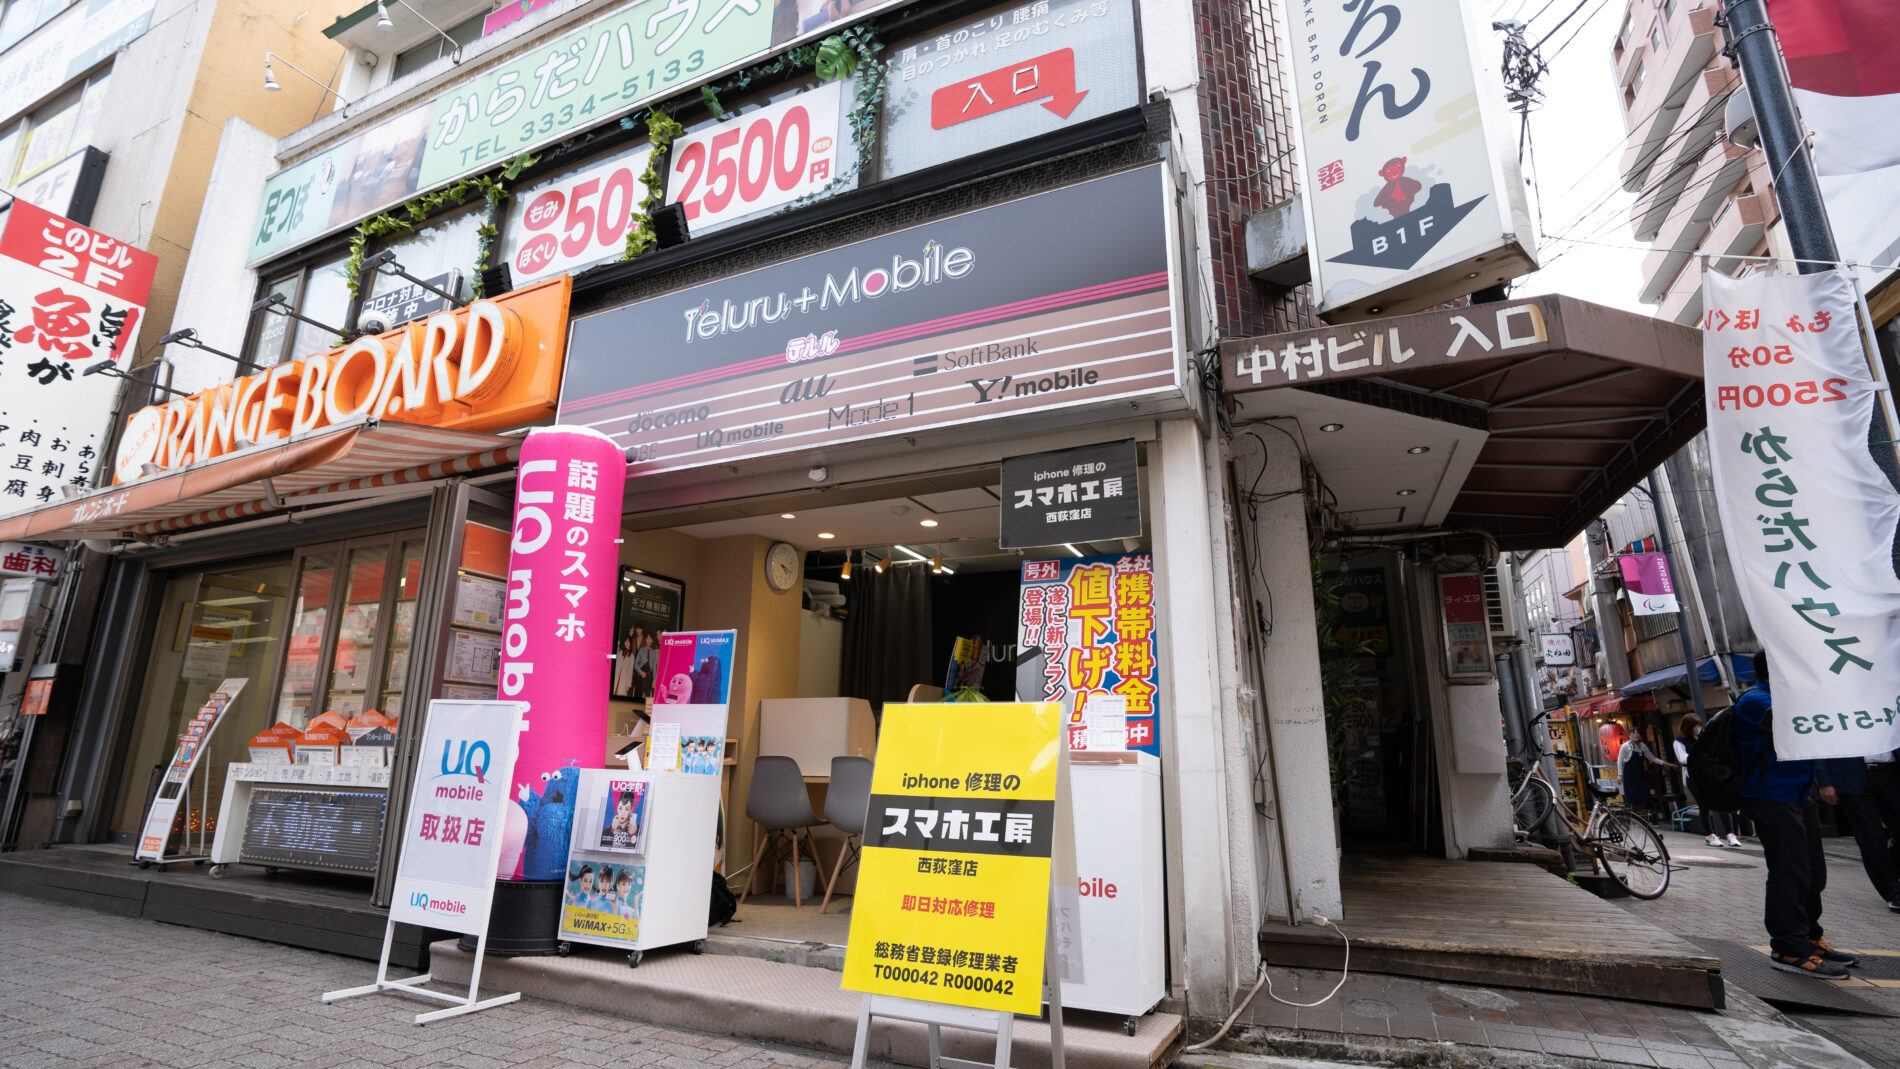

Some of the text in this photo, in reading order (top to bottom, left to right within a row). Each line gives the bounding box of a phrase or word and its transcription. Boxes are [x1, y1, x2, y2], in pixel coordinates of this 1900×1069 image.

[1012, 1, 1050, 25] 腰痛
[901, 3, 1109, 81] 目のつかれ 足のむくみ等
[963, 64, 1039, 113] 入口
[1313, 71, 1328, 124] DORON
[459, 49, 705, 168] TEL 3334-5133
[667, 105, 829, 222] 2500 円
[530, 200, 559, 222] もみ
[560, 167, 641, 259] 50
[43, 218, 132, 269] このビル
[520, 239, 558, 269] ほぐし
[39, 246, 124, 288] 2F
[786, 330, 840, 363] テルル
[943, 337, 1039, 371] SoftBank
[1237, 304, 1549, 384] 中村ビル 入口
[780, 374, 837, 405] au
[966, 368, 1099, 404] Y!mobile
[628, 405, 710, 433] docomo
[696, 421, 784, 449] UQ mobile
[2, 428, 42, 498] 肉豆腐
[36, 437, 71, 503] お刺身
[1034, 462, 1106, 482] iphone 修理の
[511, 459, 558, 555] UQ
[1014, 477, 1123, 509] スマホ工房
[1046, 508, 1092, 523] 西荻窪店
[3, 552, 56, 576] 歯科
[555, 459, 598, 642] 話題のスマホ
[1116, 555, 1151, 573] 各社
[1026, 561, 1058, 579] 号外
[1657, 558, 1671, 592] TOKYO 2020
[1046, 587, 1066, 703] 遂に新プラン
[1116, 573, 1153, 712] 携帯料金
[441, 740, 491, 783] UQ
[435, 785, 483, 801] mobile
[902, 772, 1020, 792] iphone 修理の
[420, 813, 485, 846] 取扱店
[883, 808, 1034, 844] スマホ工房
[917, 858, 978, 877] 西荻窪店
[410, 892, 466, 914] UQ mobile
[901, 894, 996, 919] 即日対応修理
[874, 941, 1019, 974] 総務省登録修理業者
[874, 965, 1014, 996] T000042 R000042
